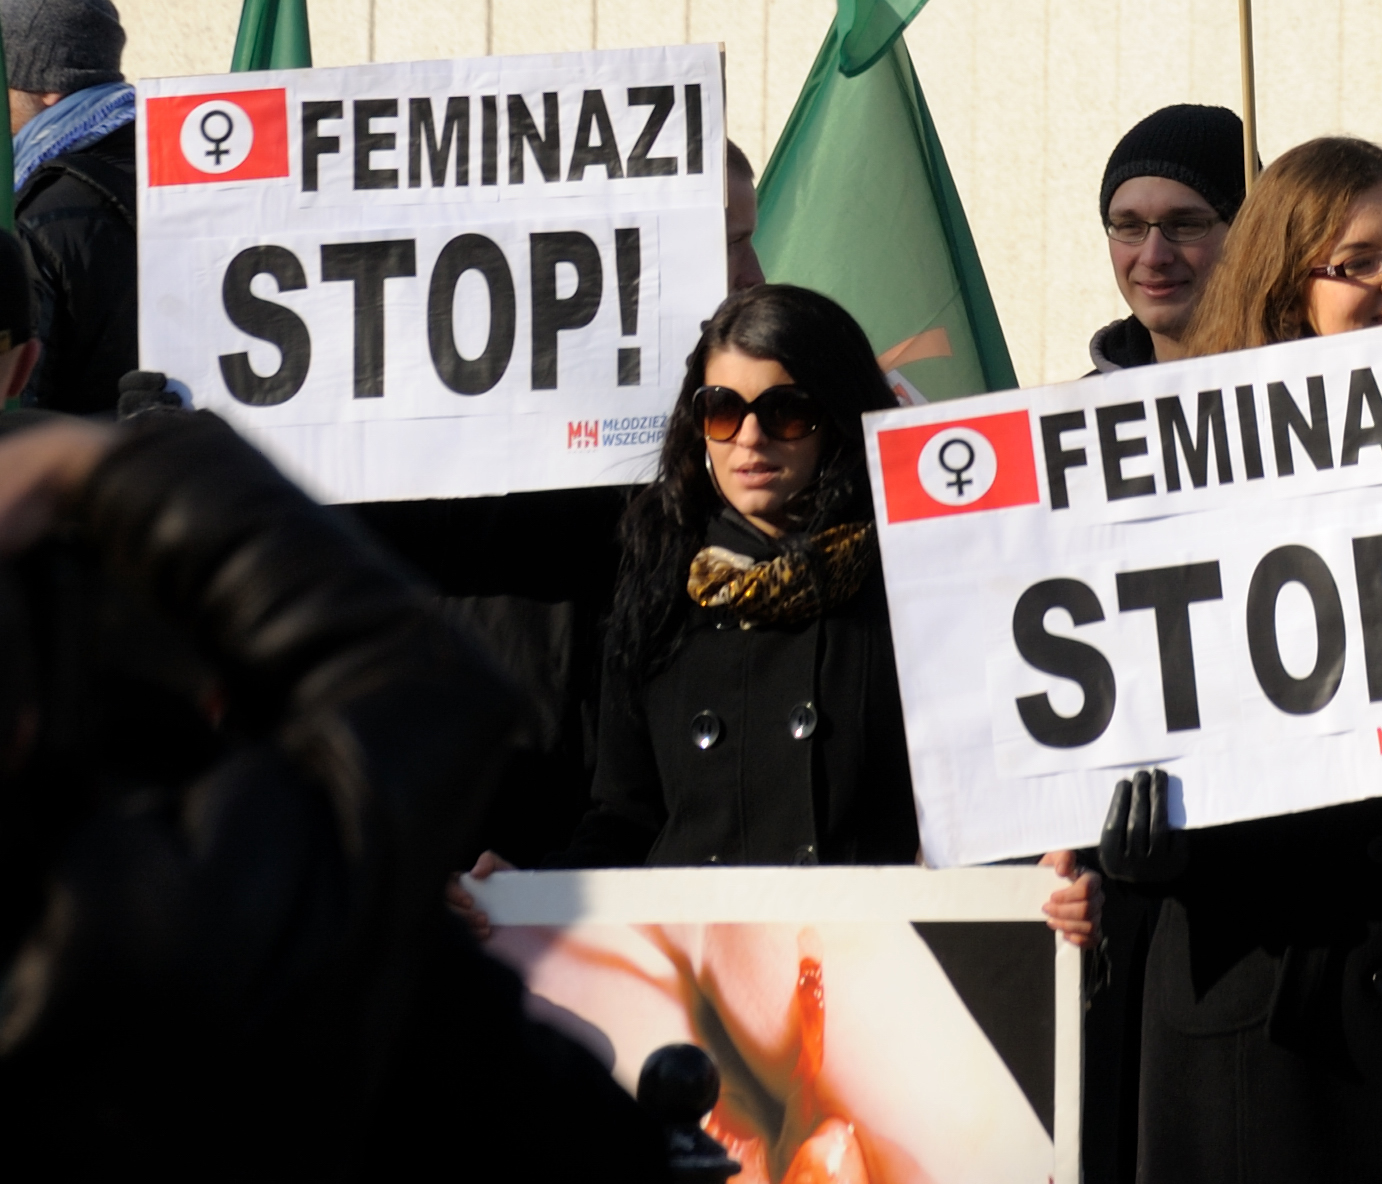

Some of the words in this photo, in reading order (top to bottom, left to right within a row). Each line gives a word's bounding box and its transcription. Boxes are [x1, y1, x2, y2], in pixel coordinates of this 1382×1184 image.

[300, 83, 703, 193] FEMINAZI
[218, 227, 642, 408] STOP!
[602, 429, 665, 447] WSZECHP
